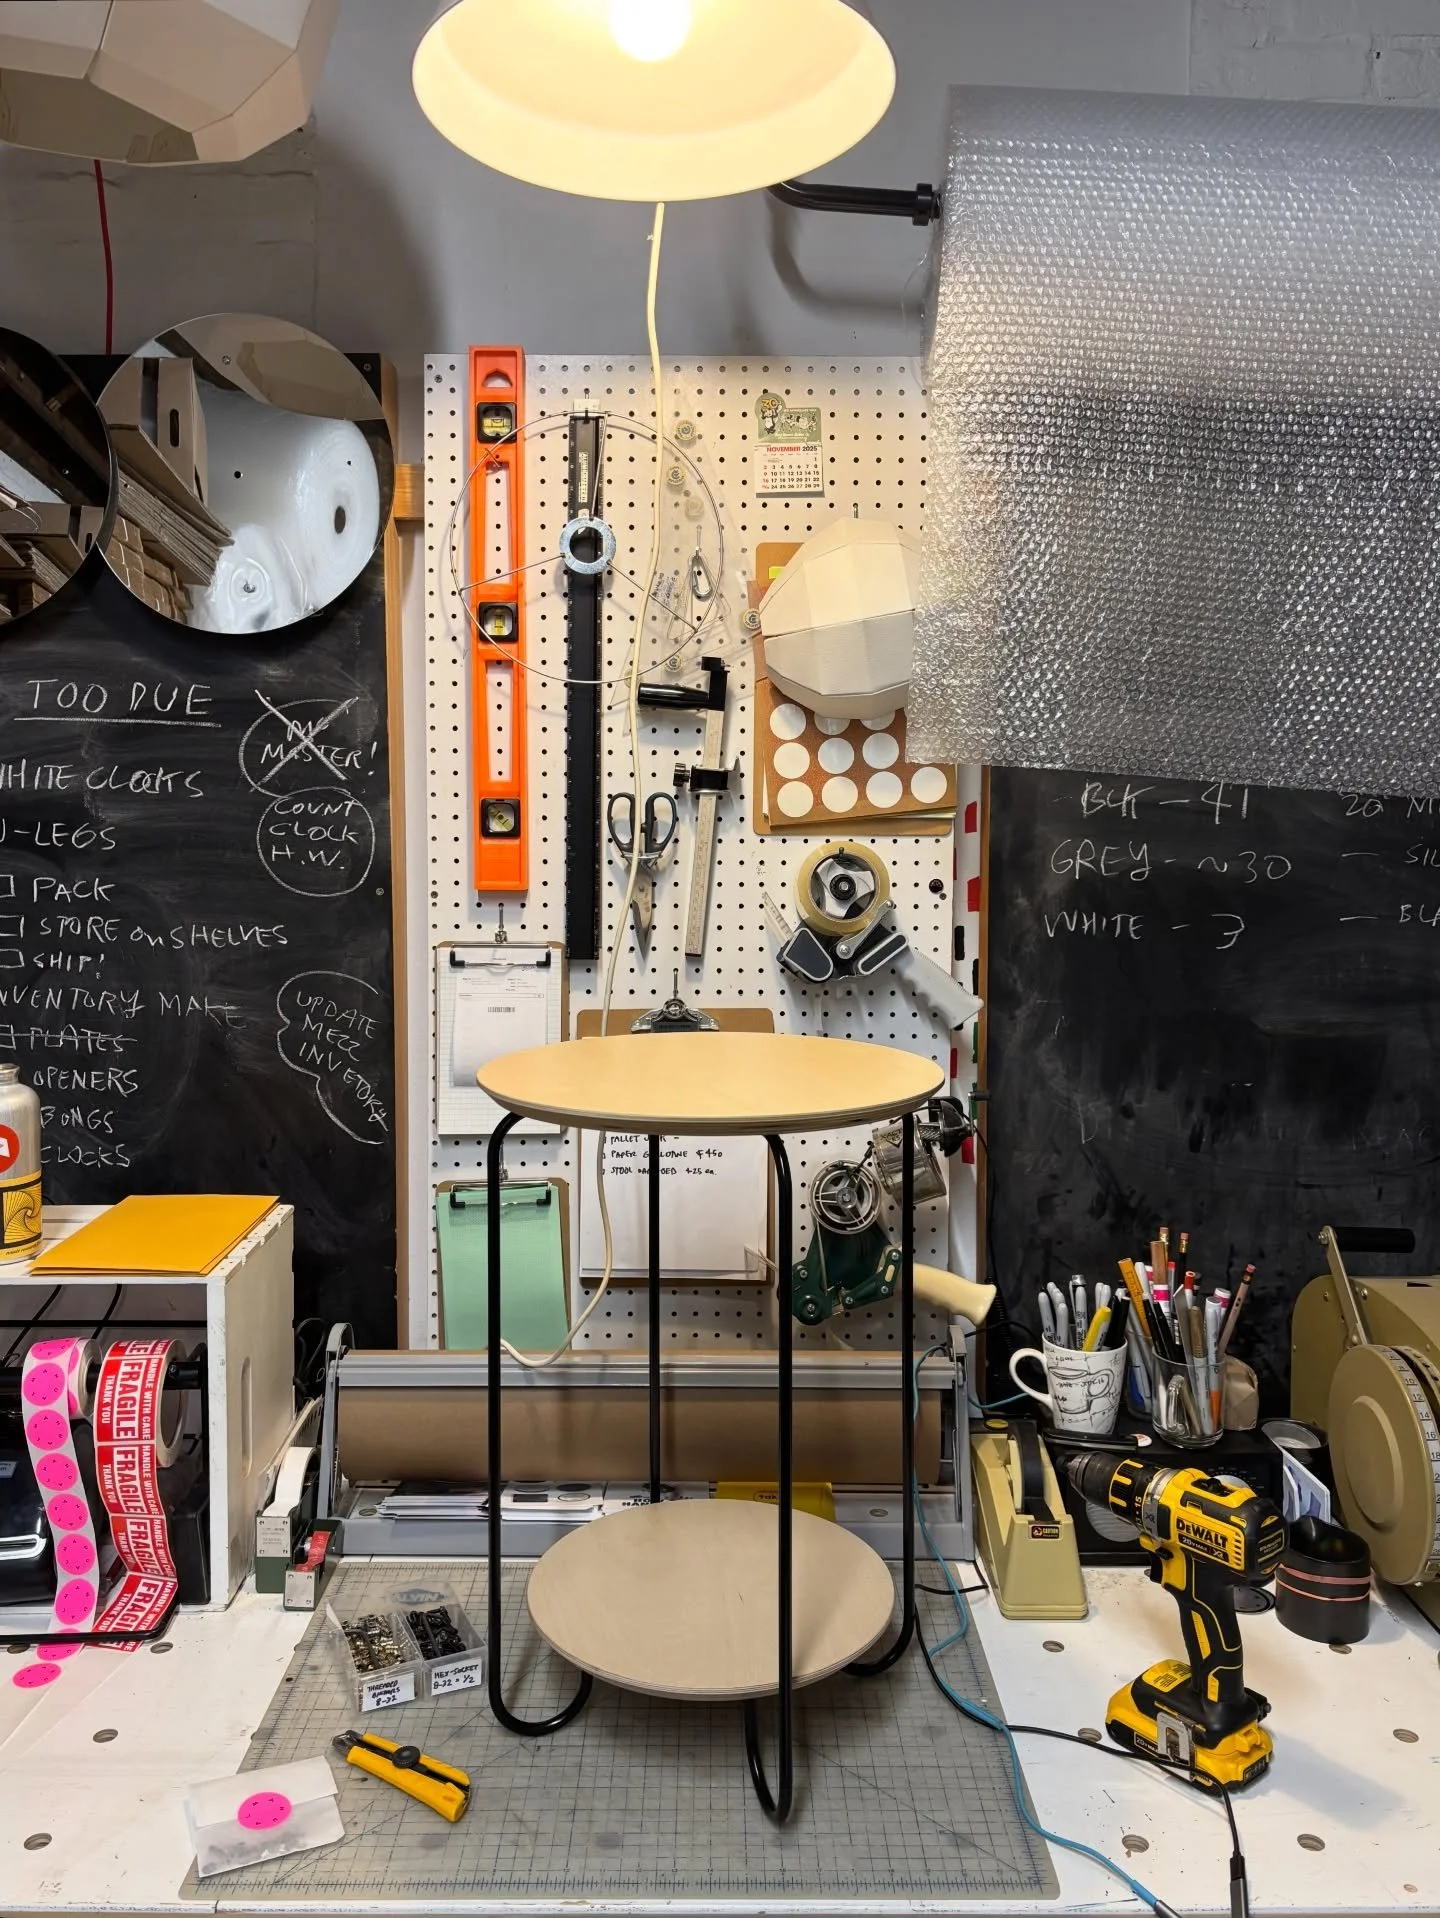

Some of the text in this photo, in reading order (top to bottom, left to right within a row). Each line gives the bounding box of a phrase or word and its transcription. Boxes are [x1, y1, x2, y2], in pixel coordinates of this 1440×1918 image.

[28, 679, 213, 715] TOO DUE
[0, 758, 80, 790] HITE
[273, 800, 362, 819] COUNT
[269, 823, 359, 845] CLOCK
[1051, 838, 1152, 882] GREY
[33, 877, 116, 903] PACK
[40, 915, 121, 943] STORE
[170, 924, 288, 949] SHELVES
[1045, 911, 1144, 940] WHITE
[1211, 913, 1246, 949] 3
[33, 951, 105, 979] SHIP!
[296, 991, 382, 1039] UPDATE
[33, 1066, 138, 1097] OPENERS
[40, 1106, 114, 1133] BONGS
[611, 1150, 638, 1159] PAPER
[101, 1375, 116, 1424] THANK YOU
[115, 1362, 144, 1438] FRAGILE
[143, 1391, 153, 1414] WITH
[1413, 1393, 1423, 1401] 12
[142, 1416, 152, 1440] CARE
[1426, 1431, 1436, 1439] 16
[142, 1445, 152, 1478] HANDLE
[102, 1463, 114, 1490] THANK
[116, 1449, 146, 1514] FRAGILE
[143, 1480, 155, 1499] WITH
[1135, 1495, 1142, 1508] 15
[153, 1518, 163, 1548] HANDLE
[129, 1520, 161, 1576] FRAGILE
[111, 1593, 132, 1620] THANK
[153, 1581, 176, 1612] HANDLE
